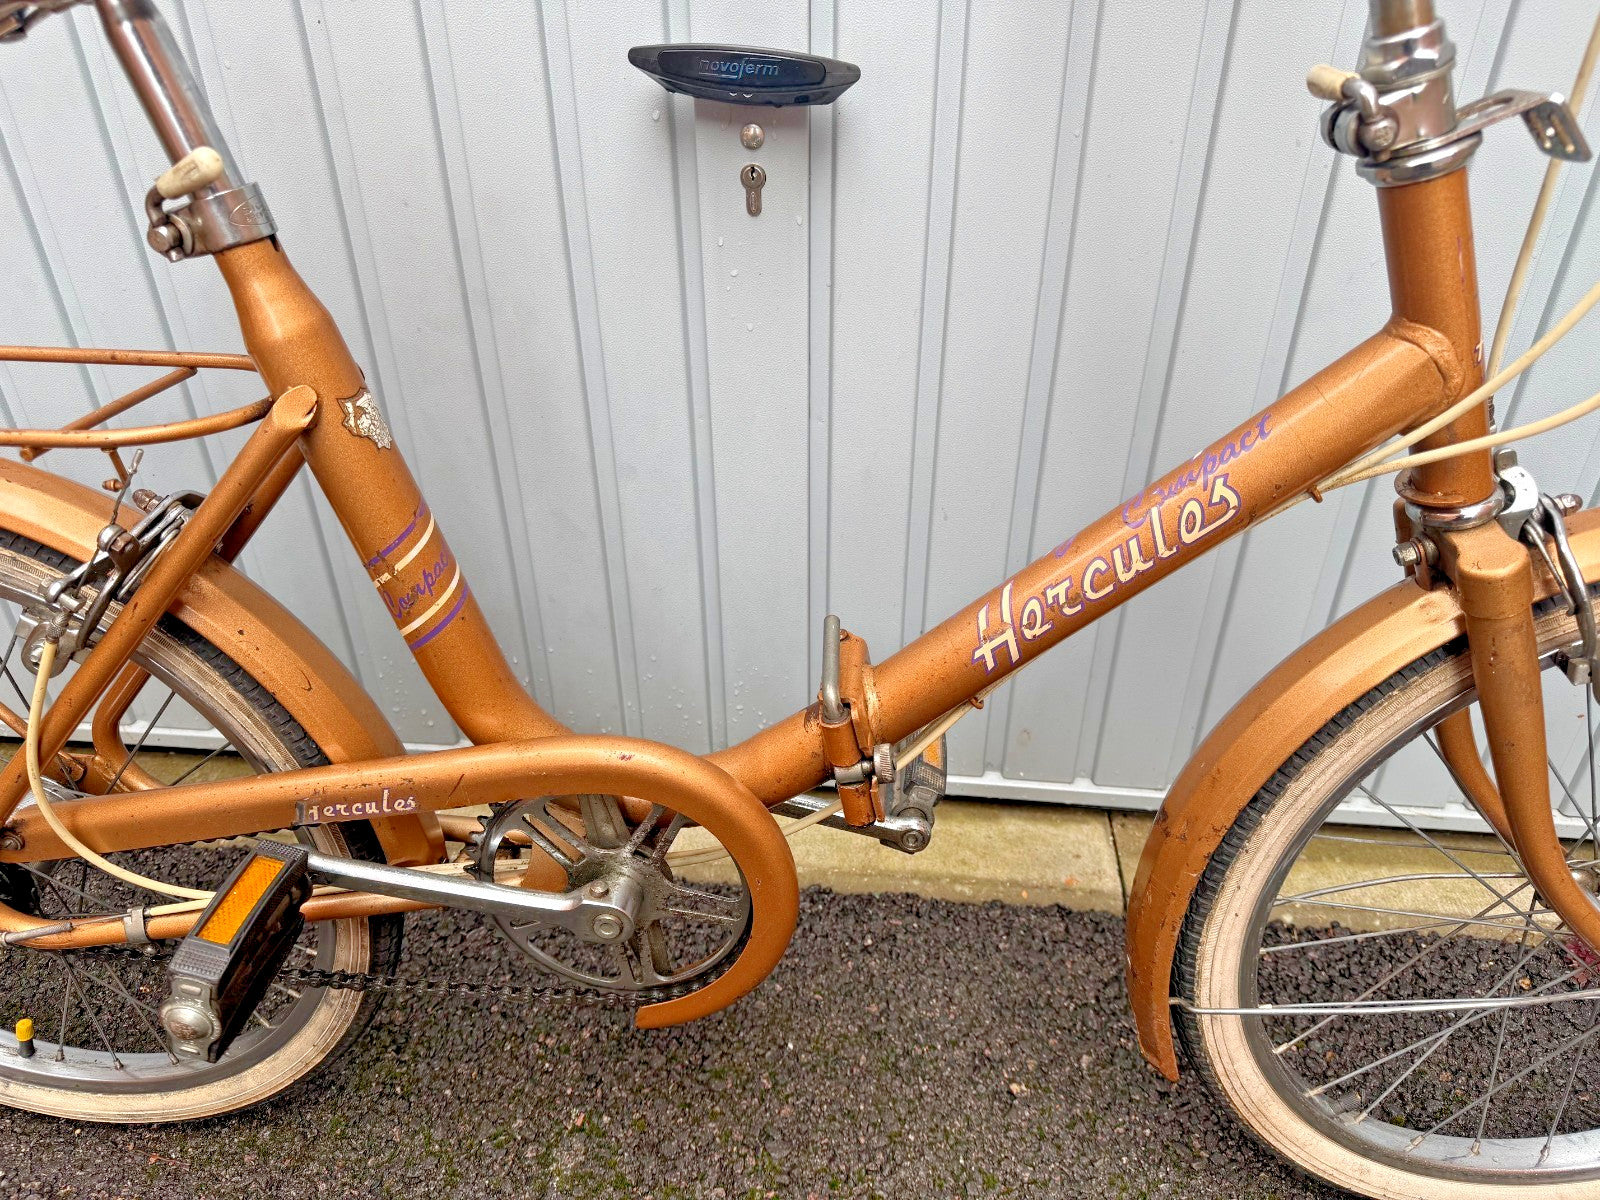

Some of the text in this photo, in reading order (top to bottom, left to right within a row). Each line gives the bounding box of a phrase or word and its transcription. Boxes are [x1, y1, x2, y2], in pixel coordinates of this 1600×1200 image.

[699, 57, 781, 79] novoferm
[381, 540, 451, 618] Compac
[971, 472, 1242, 675] Hercules
